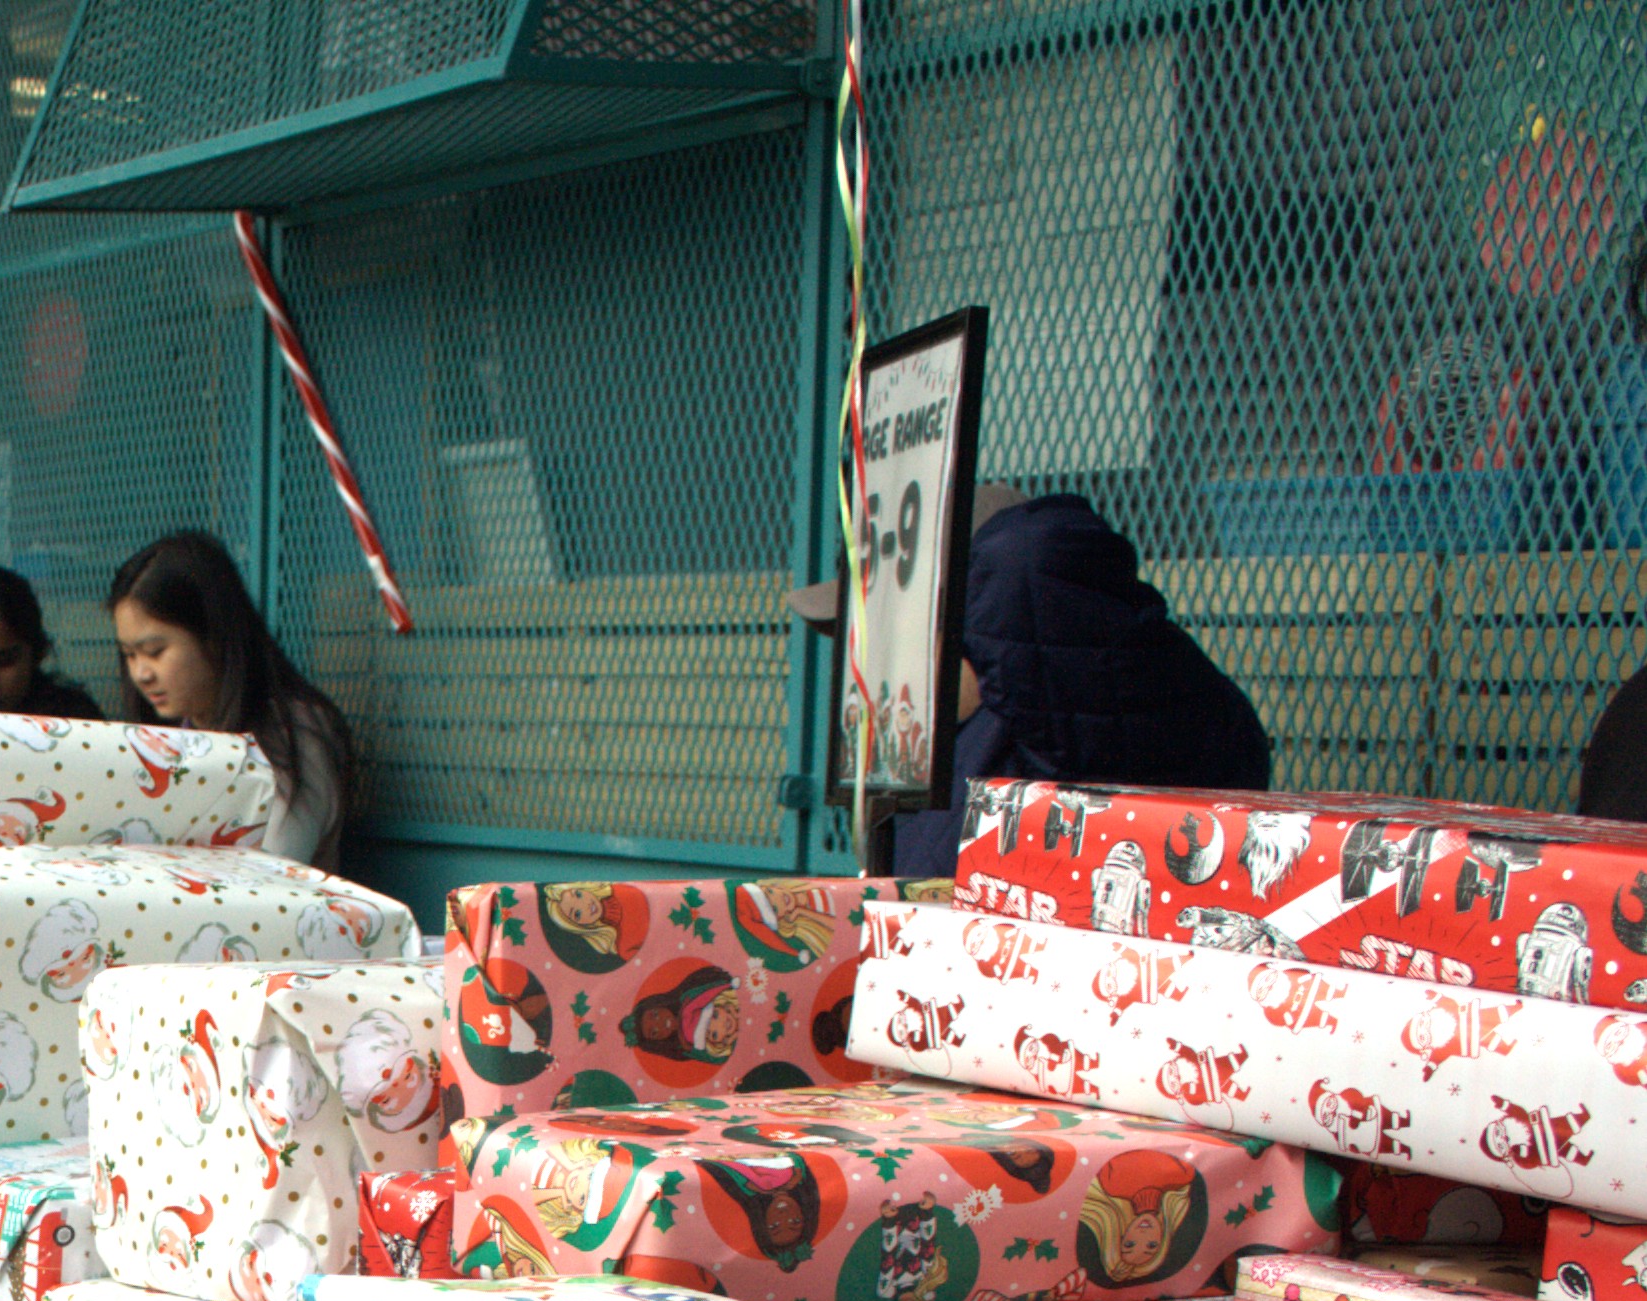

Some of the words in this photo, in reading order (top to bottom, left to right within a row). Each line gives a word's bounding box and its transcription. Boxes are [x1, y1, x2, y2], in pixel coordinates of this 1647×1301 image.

[893, 395, 948, 455] RANGE
[859, 479, 922, 594] 5-9
[954, 871, 1066, 926] STAR
